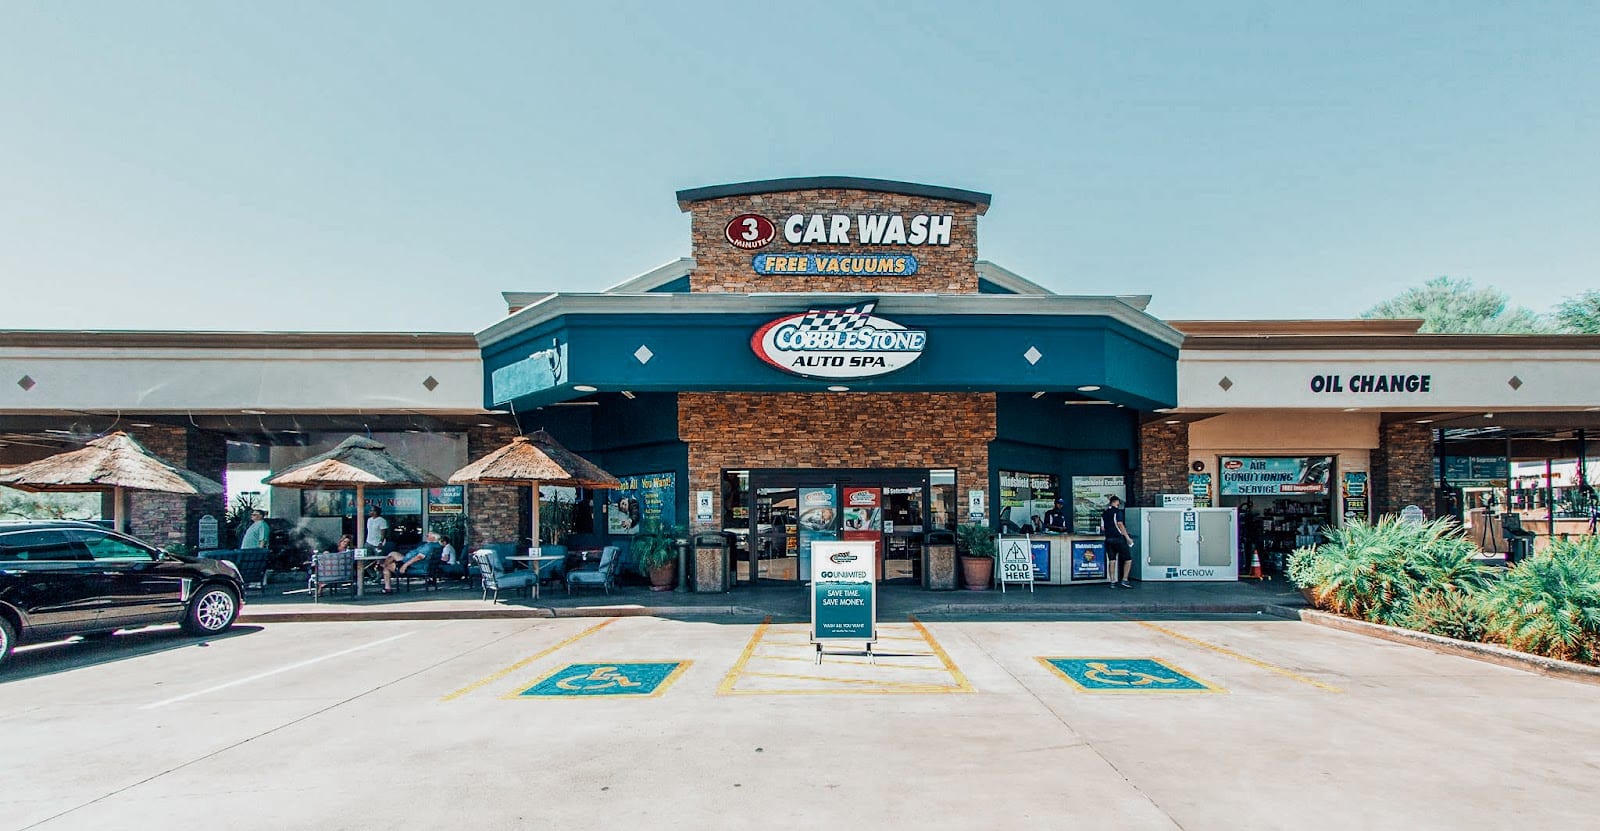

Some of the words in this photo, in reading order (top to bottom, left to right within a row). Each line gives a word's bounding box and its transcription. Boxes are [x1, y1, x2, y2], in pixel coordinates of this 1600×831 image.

[741, 217, 759, 240] 3
[784, 214, 851, 245] CAR
[857, 214, 953, 246] WASH
[733, 238, 770, 249] MINUTE
[764, 257, 809, 272] FREE
[815, 257, 906, 272] VACUUMS
[791, 356, 844, 367] AUTO
[848, 356, 886, 367] SPA
[1310, 375, 1343, 392] OIL
[1349, 374, 1431, 393] CHANGE
[1249, 461, 1267, 470] AIR
[1000, 476, 1029, 488] Windshield
[1224, 472, 1294, 482] CONDITIONING
[642, 478, 652, 488] You
[1238, 484, 1277, 493] SERVICE
[348, 499, 383, 507] APLY
[1004, 564, 1029, 572] SOLD
[1179, 569, 1214, 577] ICENOW
[1005, 572, 1030, 580] HERE
[823, 598, 839, 606] SAVE
